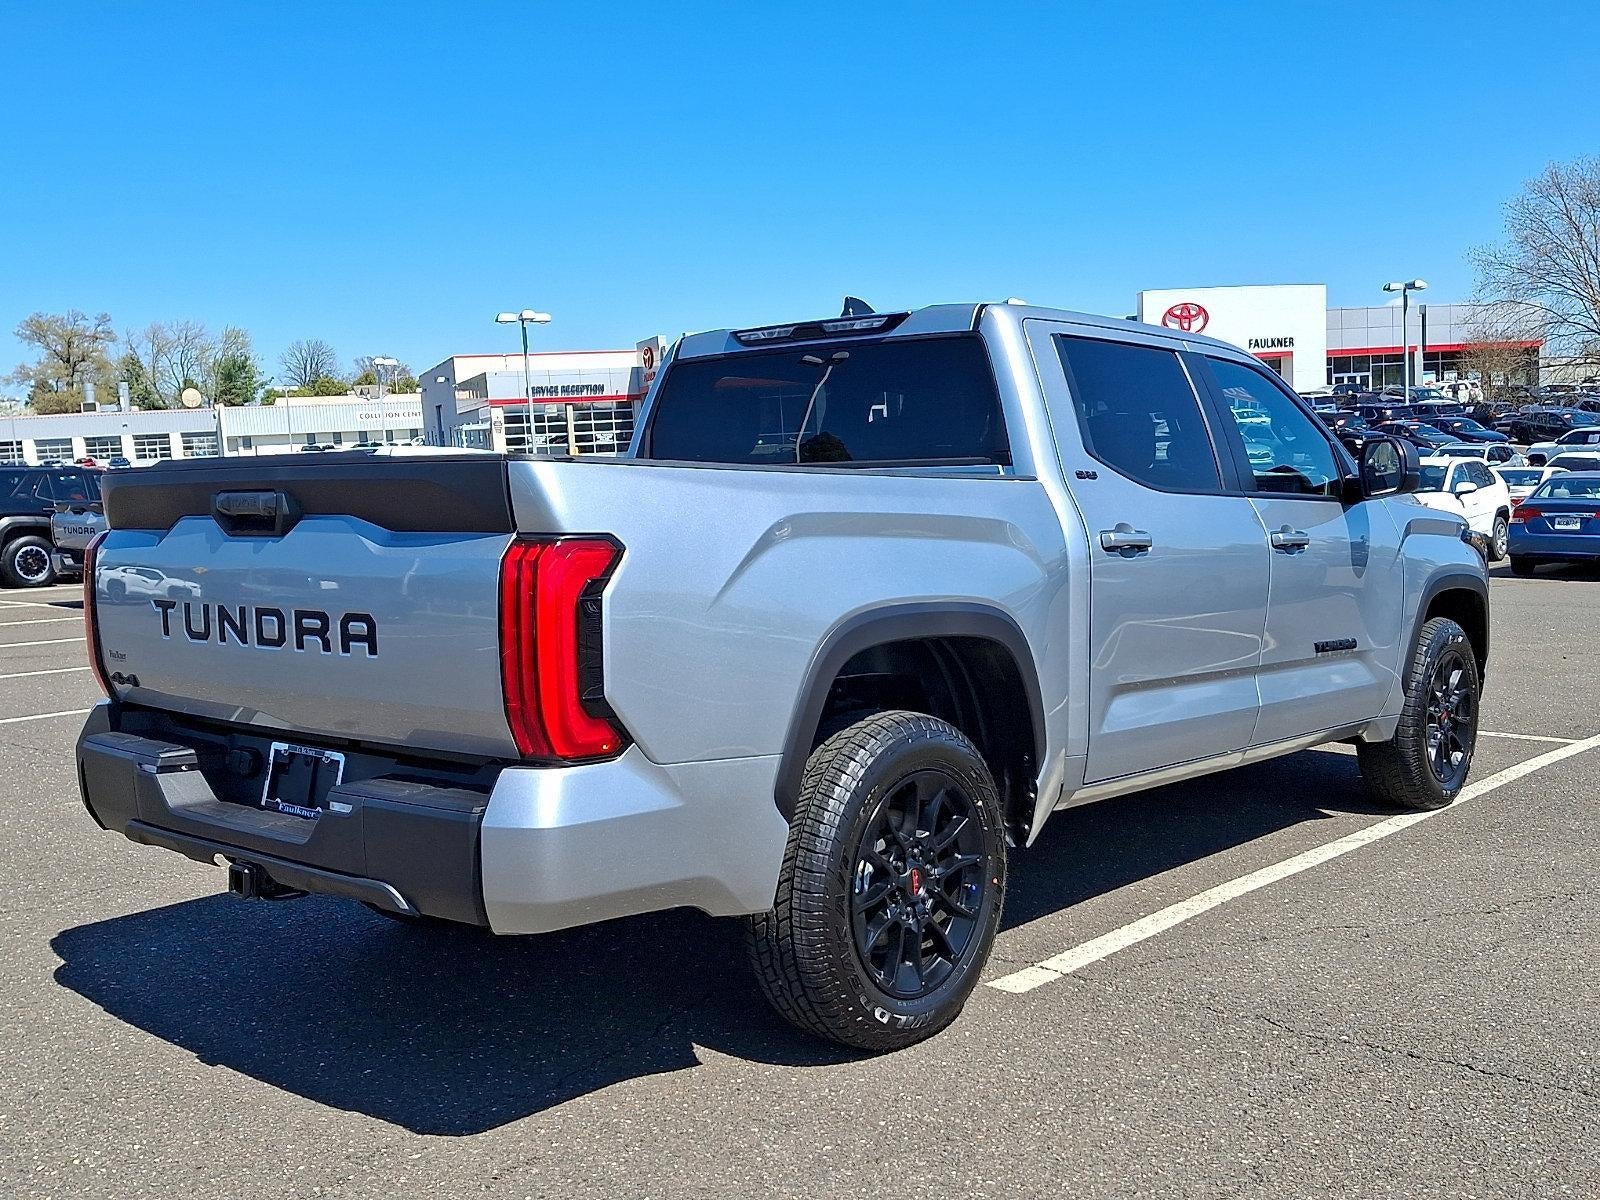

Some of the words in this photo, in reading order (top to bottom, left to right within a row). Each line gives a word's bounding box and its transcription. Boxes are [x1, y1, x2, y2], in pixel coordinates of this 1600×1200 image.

[1248, 336, 1295, 350] FAULKNER
[525, 384, 559, 398] ERVICE
[560, 383, 605, 397] RECEPTION
[359, 412, 400, 420] COLLIION
[63, 526, 97, 535] TUNDRA
[151, 599, 378, 658] TUNDRA
[278, 802, 318, 818] Faulkner
